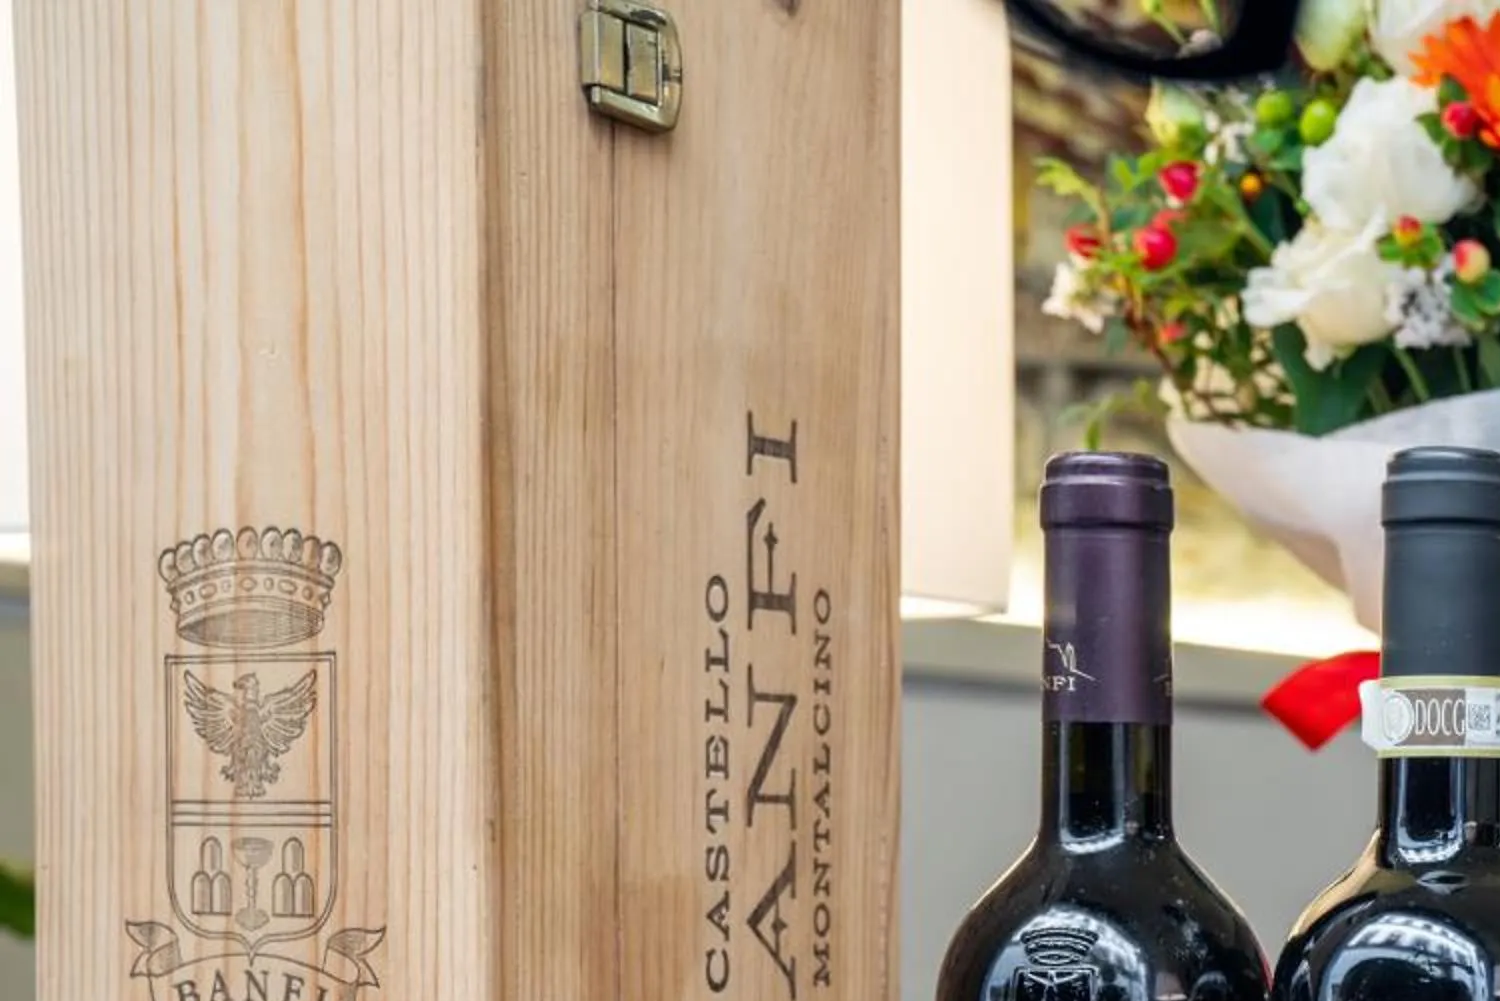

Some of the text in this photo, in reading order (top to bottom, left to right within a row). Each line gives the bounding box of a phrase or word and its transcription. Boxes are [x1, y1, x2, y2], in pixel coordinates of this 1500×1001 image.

[705, 574, 731, 993] CASTELLO
[812, 587, 832, 989] MONTALCINO
[1415, 698, 1466, 737] DOCG
